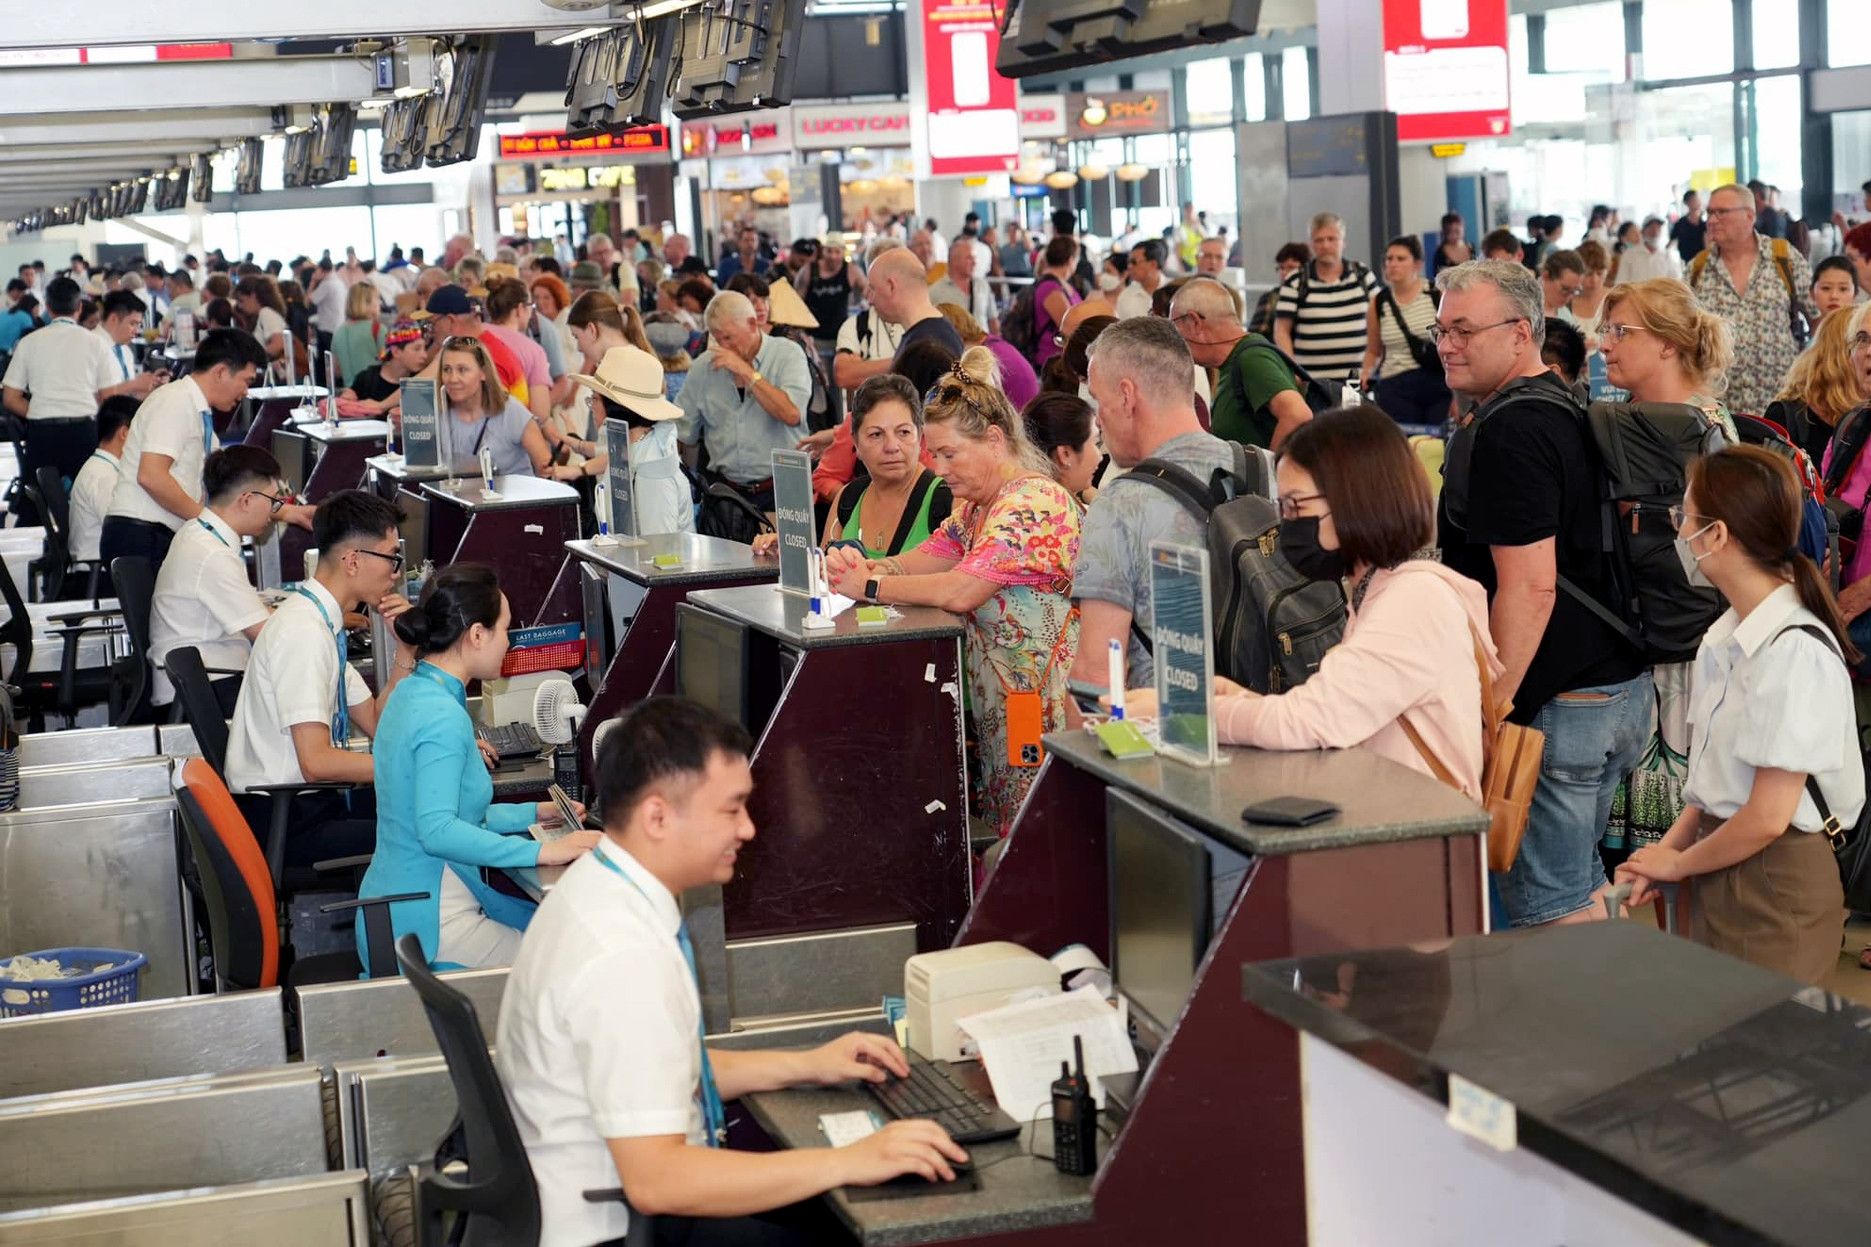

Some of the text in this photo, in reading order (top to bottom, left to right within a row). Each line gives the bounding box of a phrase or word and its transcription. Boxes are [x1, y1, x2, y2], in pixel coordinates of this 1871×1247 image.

[803, 116, 866, 135] LUCKY
[409, 431, 431, 440] CLOSED
[785, 533, 807, 549] CLOSED
[516, 633, 531, 641] LAST
[533, 628, 567, 638] BAGGAGE
[1165, 664, 1198, 691] CLOSED
